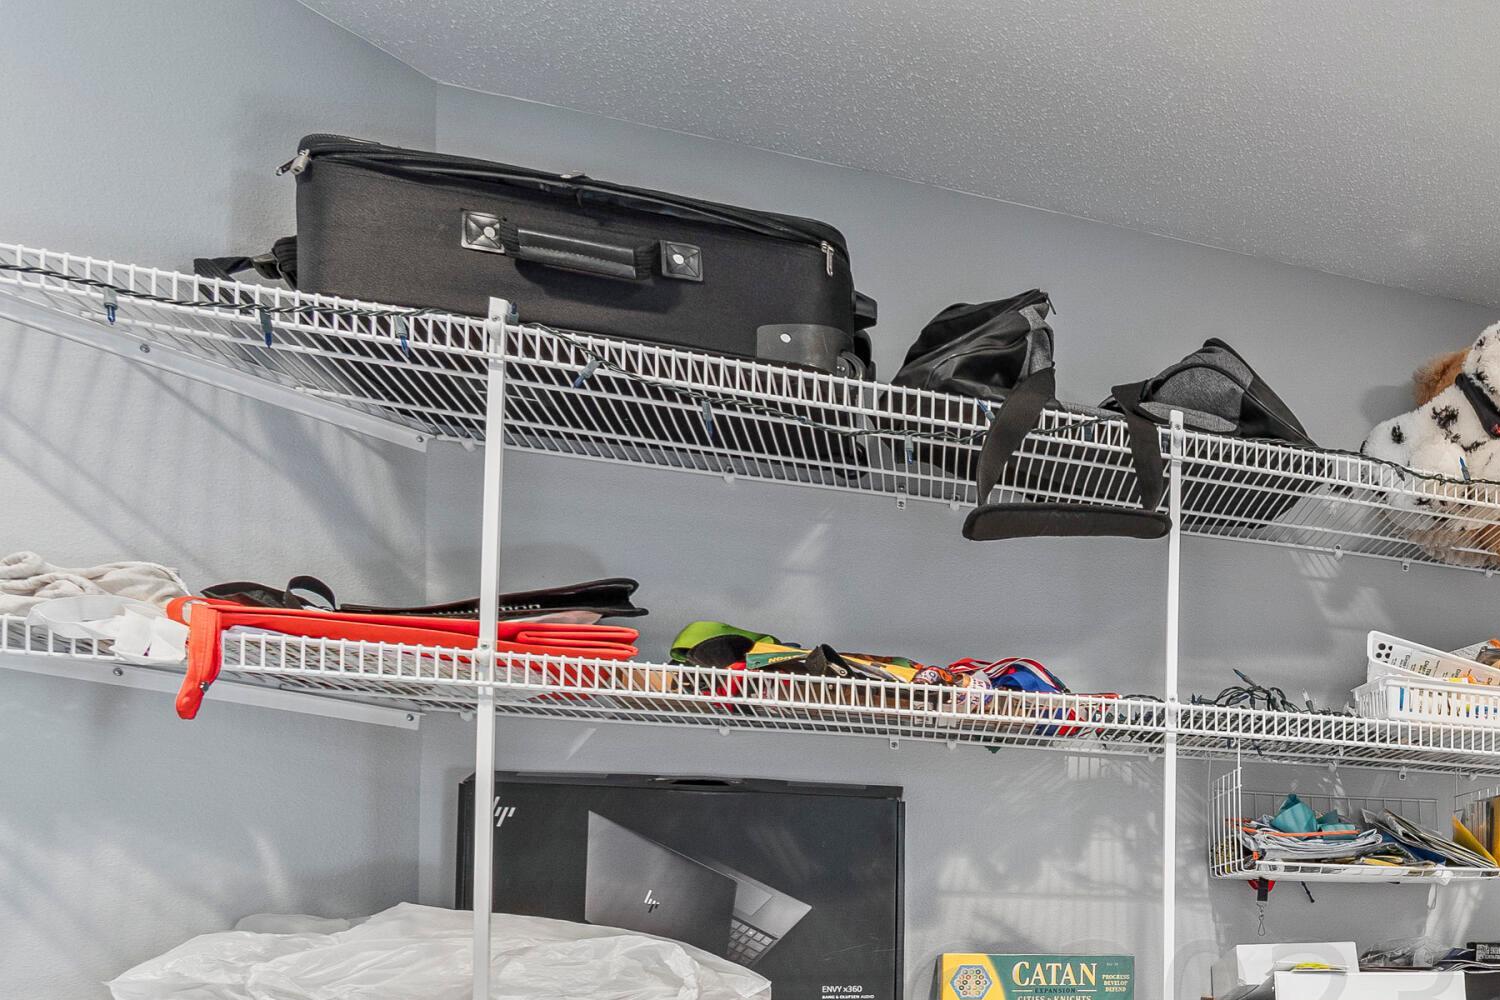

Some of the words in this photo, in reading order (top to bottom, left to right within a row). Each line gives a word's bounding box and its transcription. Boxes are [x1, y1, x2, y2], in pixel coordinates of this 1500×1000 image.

[1012, 961, 1098, 987] CATAN
[821, 985, 843, 993] ENVY
[843, 985, 863, 993] x360
